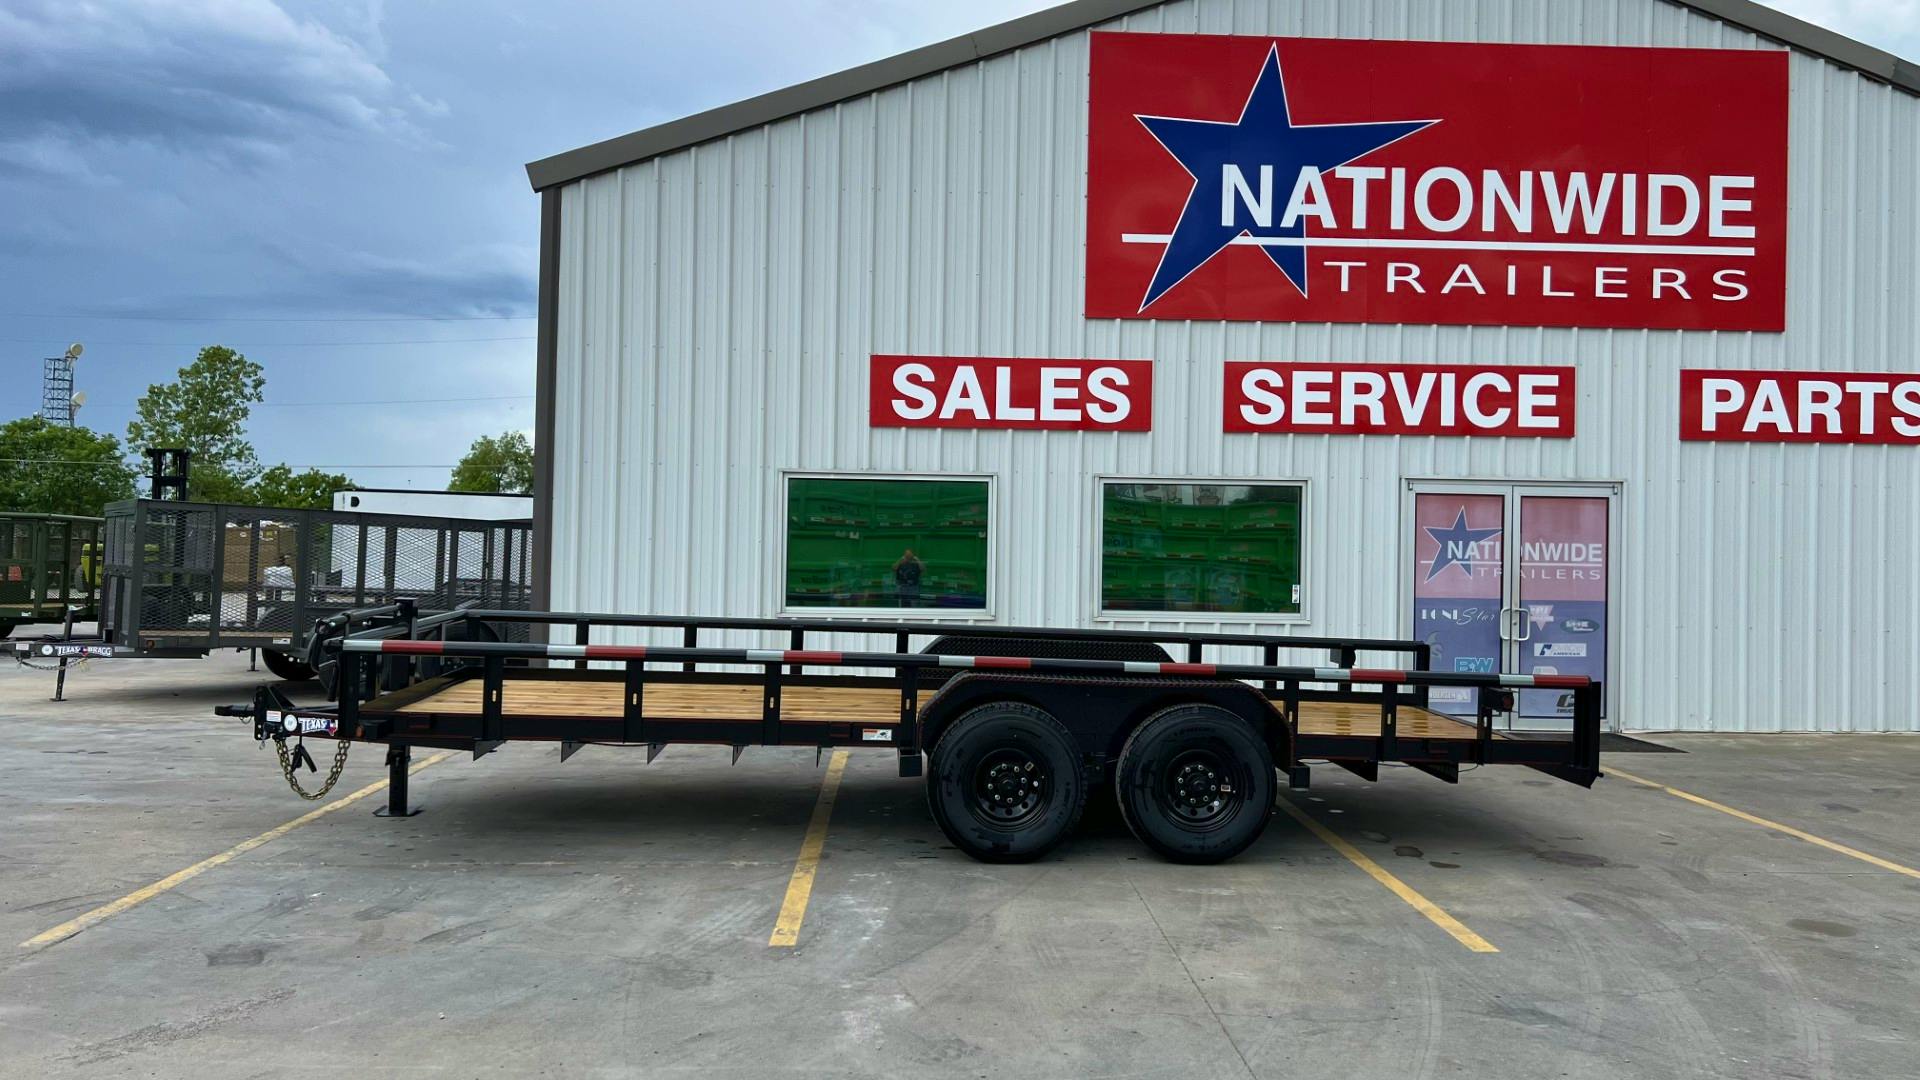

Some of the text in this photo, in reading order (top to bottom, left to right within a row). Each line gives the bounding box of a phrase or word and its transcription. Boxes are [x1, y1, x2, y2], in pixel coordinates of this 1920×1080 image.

[1220, 163, 1756, 239] NATIONWIDE
[1323, 260, 1750, 301] TRAILERS
[891, 363, 1131, 424] SALES
[1239, 368, 1560, 429] SERVICE
[1701, 378, 1920, 437] PARTS
[1447, 540, 1603, 562] NATINWIDE
[54, 645, 81, 656] TEXAS
[298, 717, 328, 733] TEXAS
